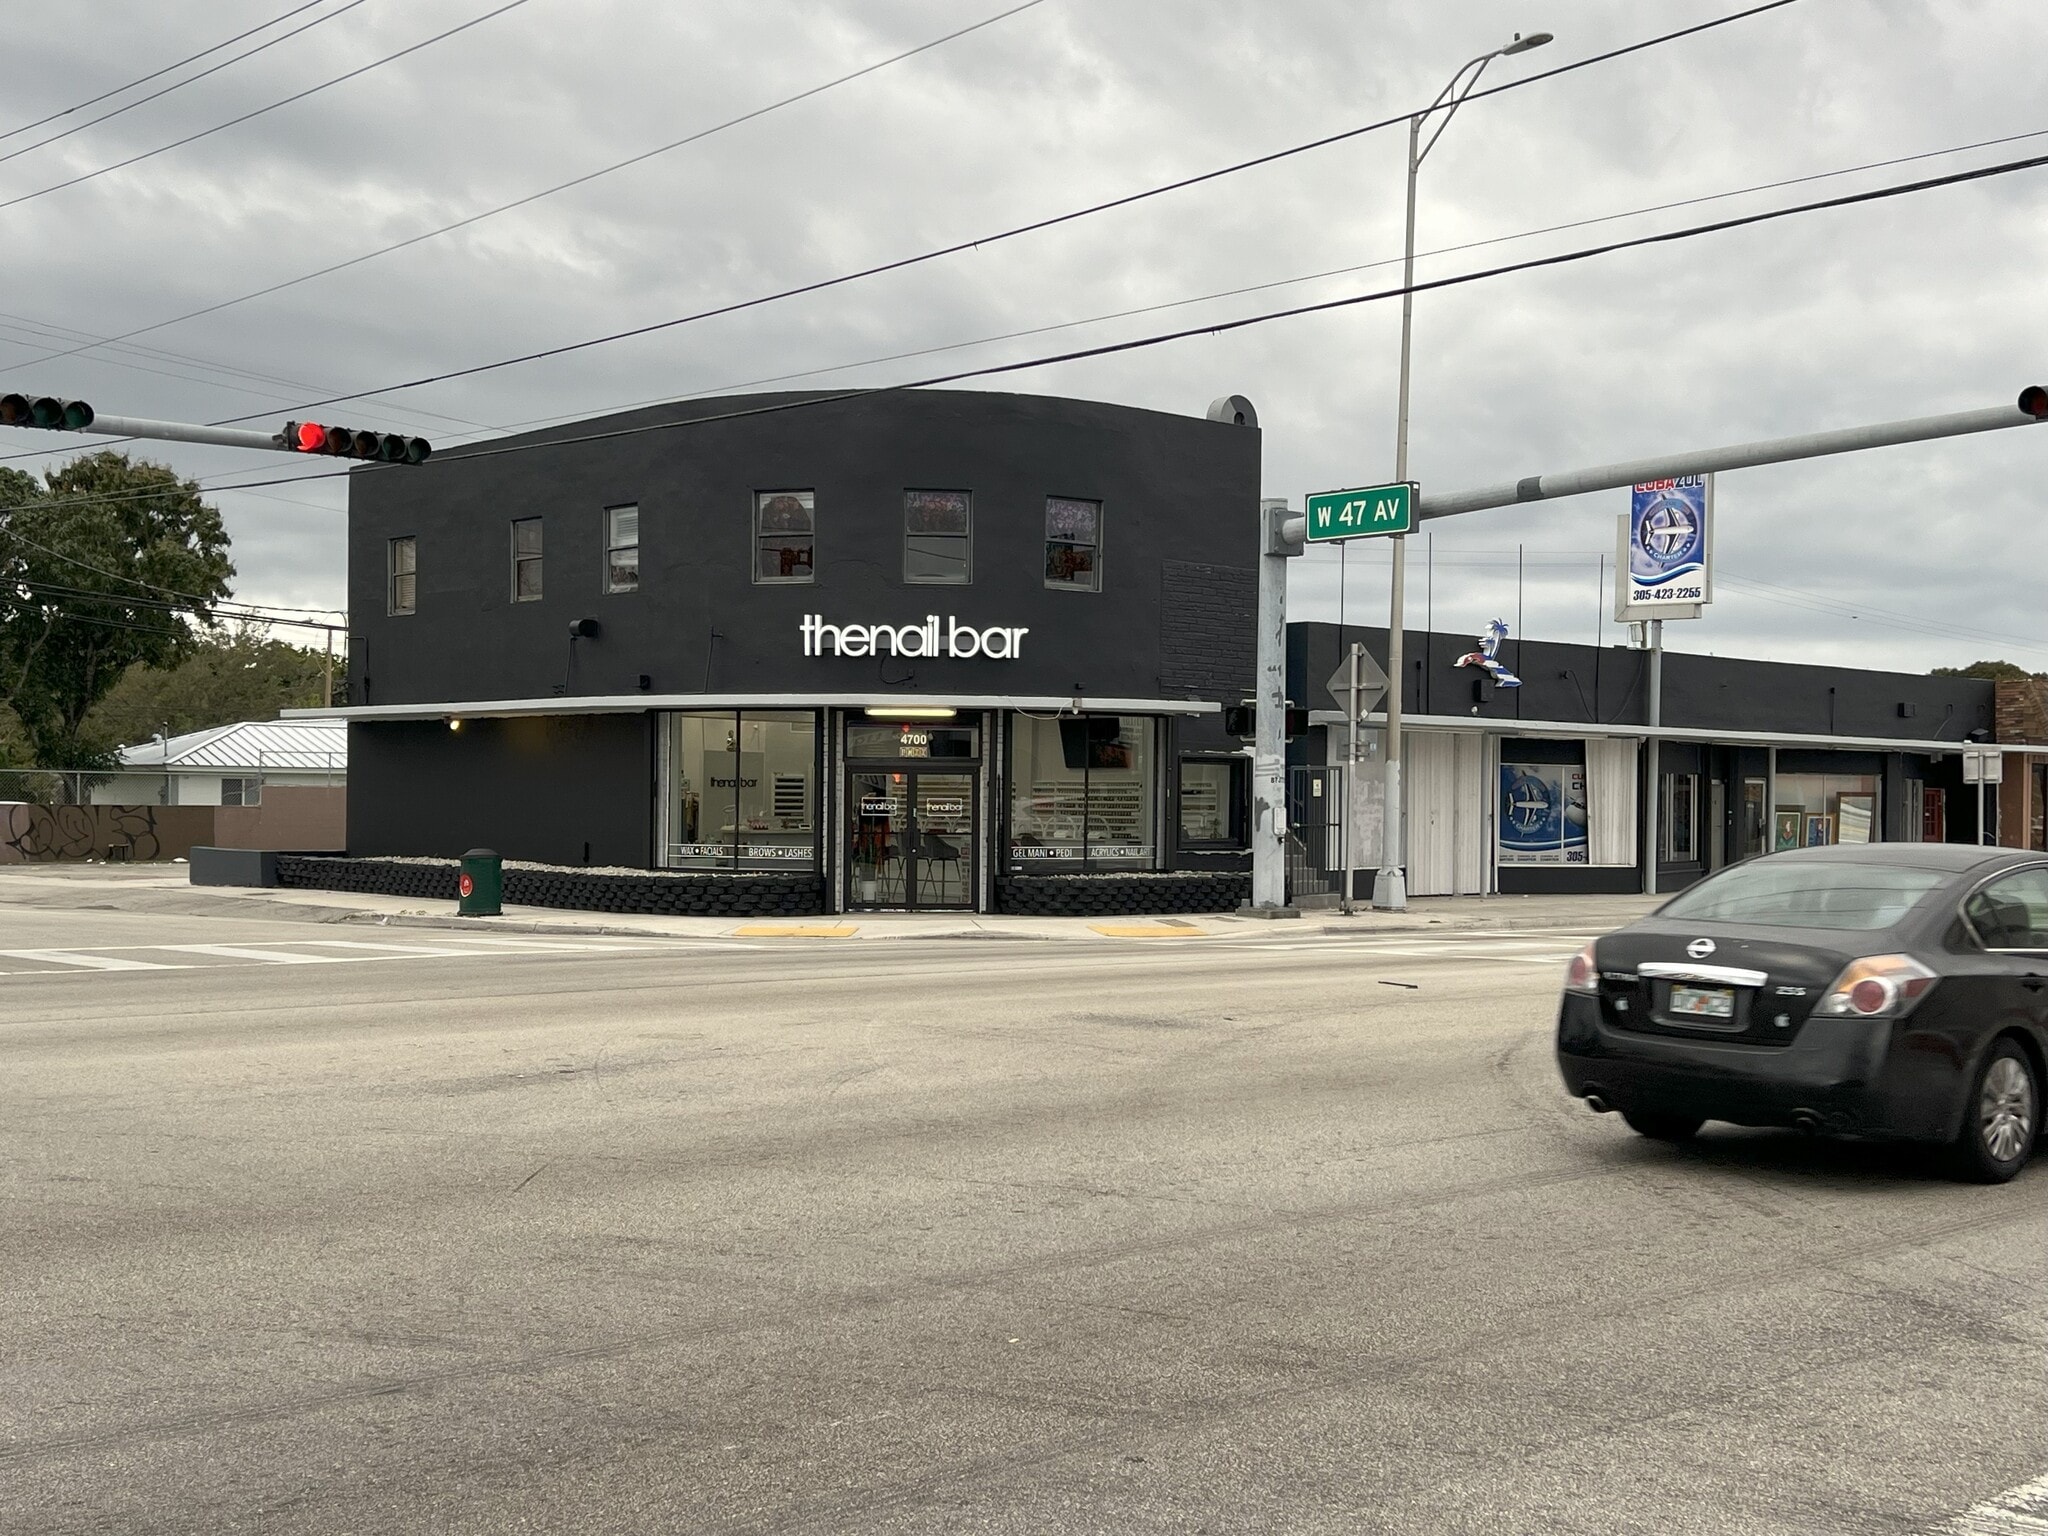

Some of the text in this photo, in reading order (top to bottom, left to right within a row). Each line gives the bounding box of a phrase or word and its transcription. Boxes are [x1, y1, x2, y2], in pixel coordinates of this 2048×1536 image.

[1317, 498, 1400, 528] W 47 AV
[1633, 587, 1702, 601] 305-423-2255
[949, 615, 1030, 659] bar
[900, 734, 927, 745] 4700
[680, 847, 695, 855] WAX
[748, 848, 813, 858] BROWS LASHES
[1012, 848, 1073, 858] GEL MANI PEDI
[1090, 847, 1120, 857] ACRYLICS
[1125, 847, 1140, 857] NAIL
